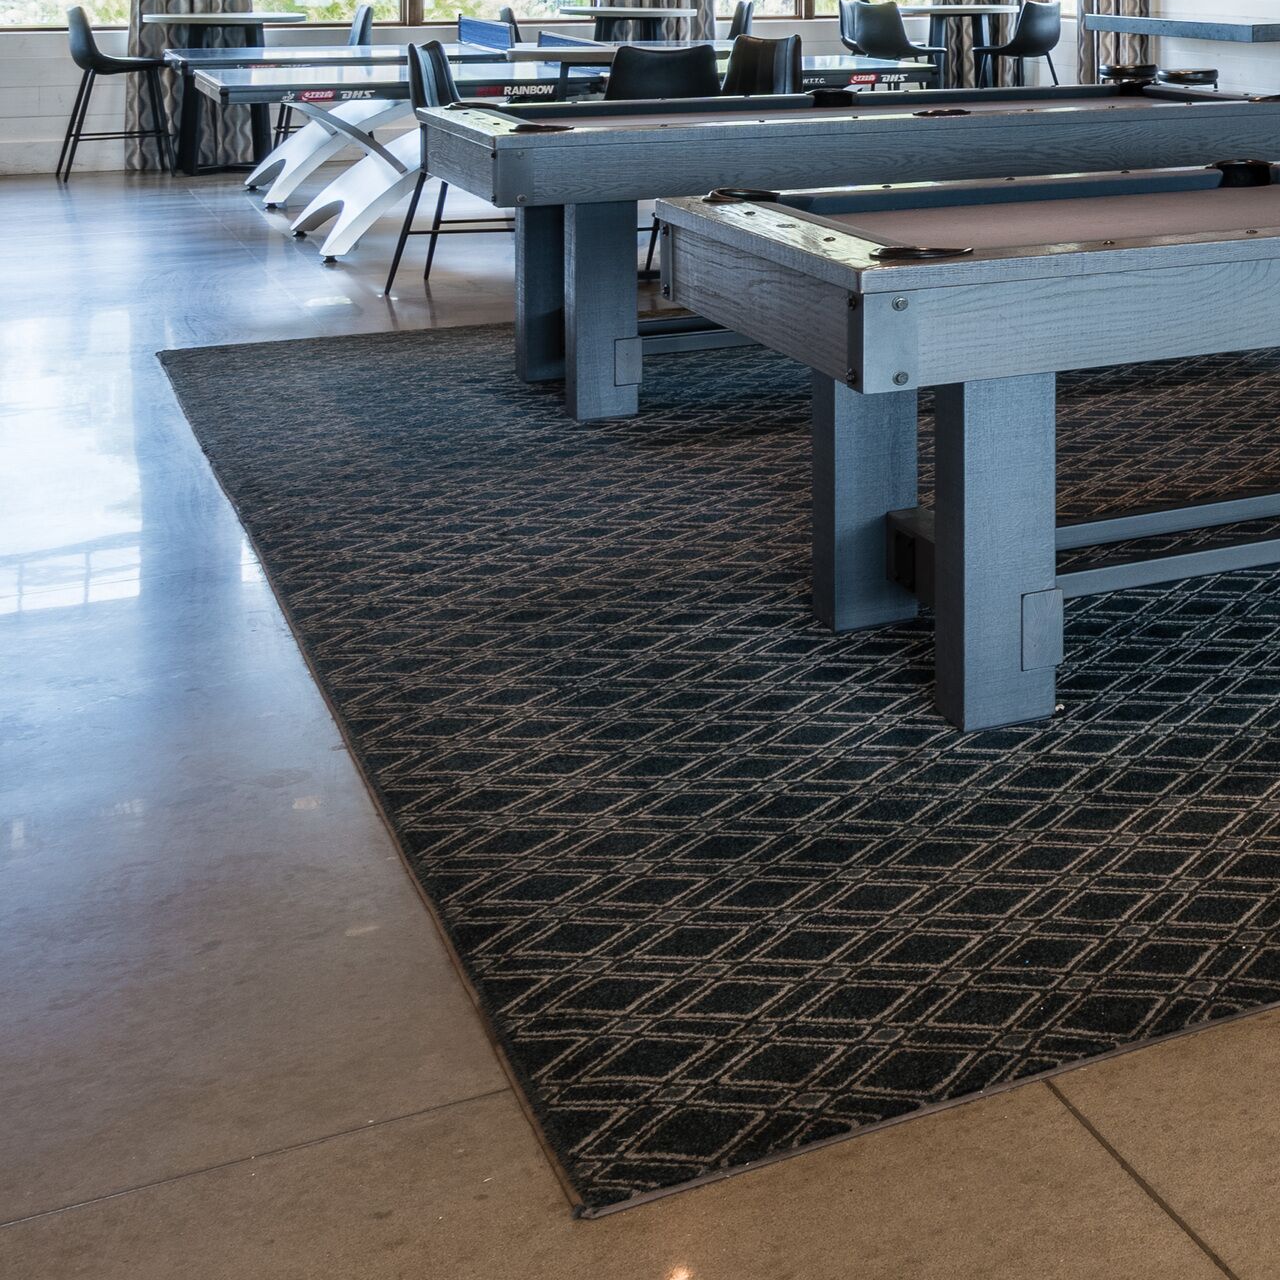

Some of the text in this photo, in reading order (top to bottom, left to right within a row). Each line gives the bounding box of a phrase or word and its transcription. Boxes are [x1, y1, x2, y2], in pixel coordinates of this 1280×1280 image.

[880, 74, 908, 82] DHS
[340, 90, 375, 99] DHS
[504, 85, 554, 95] RAINBOW
